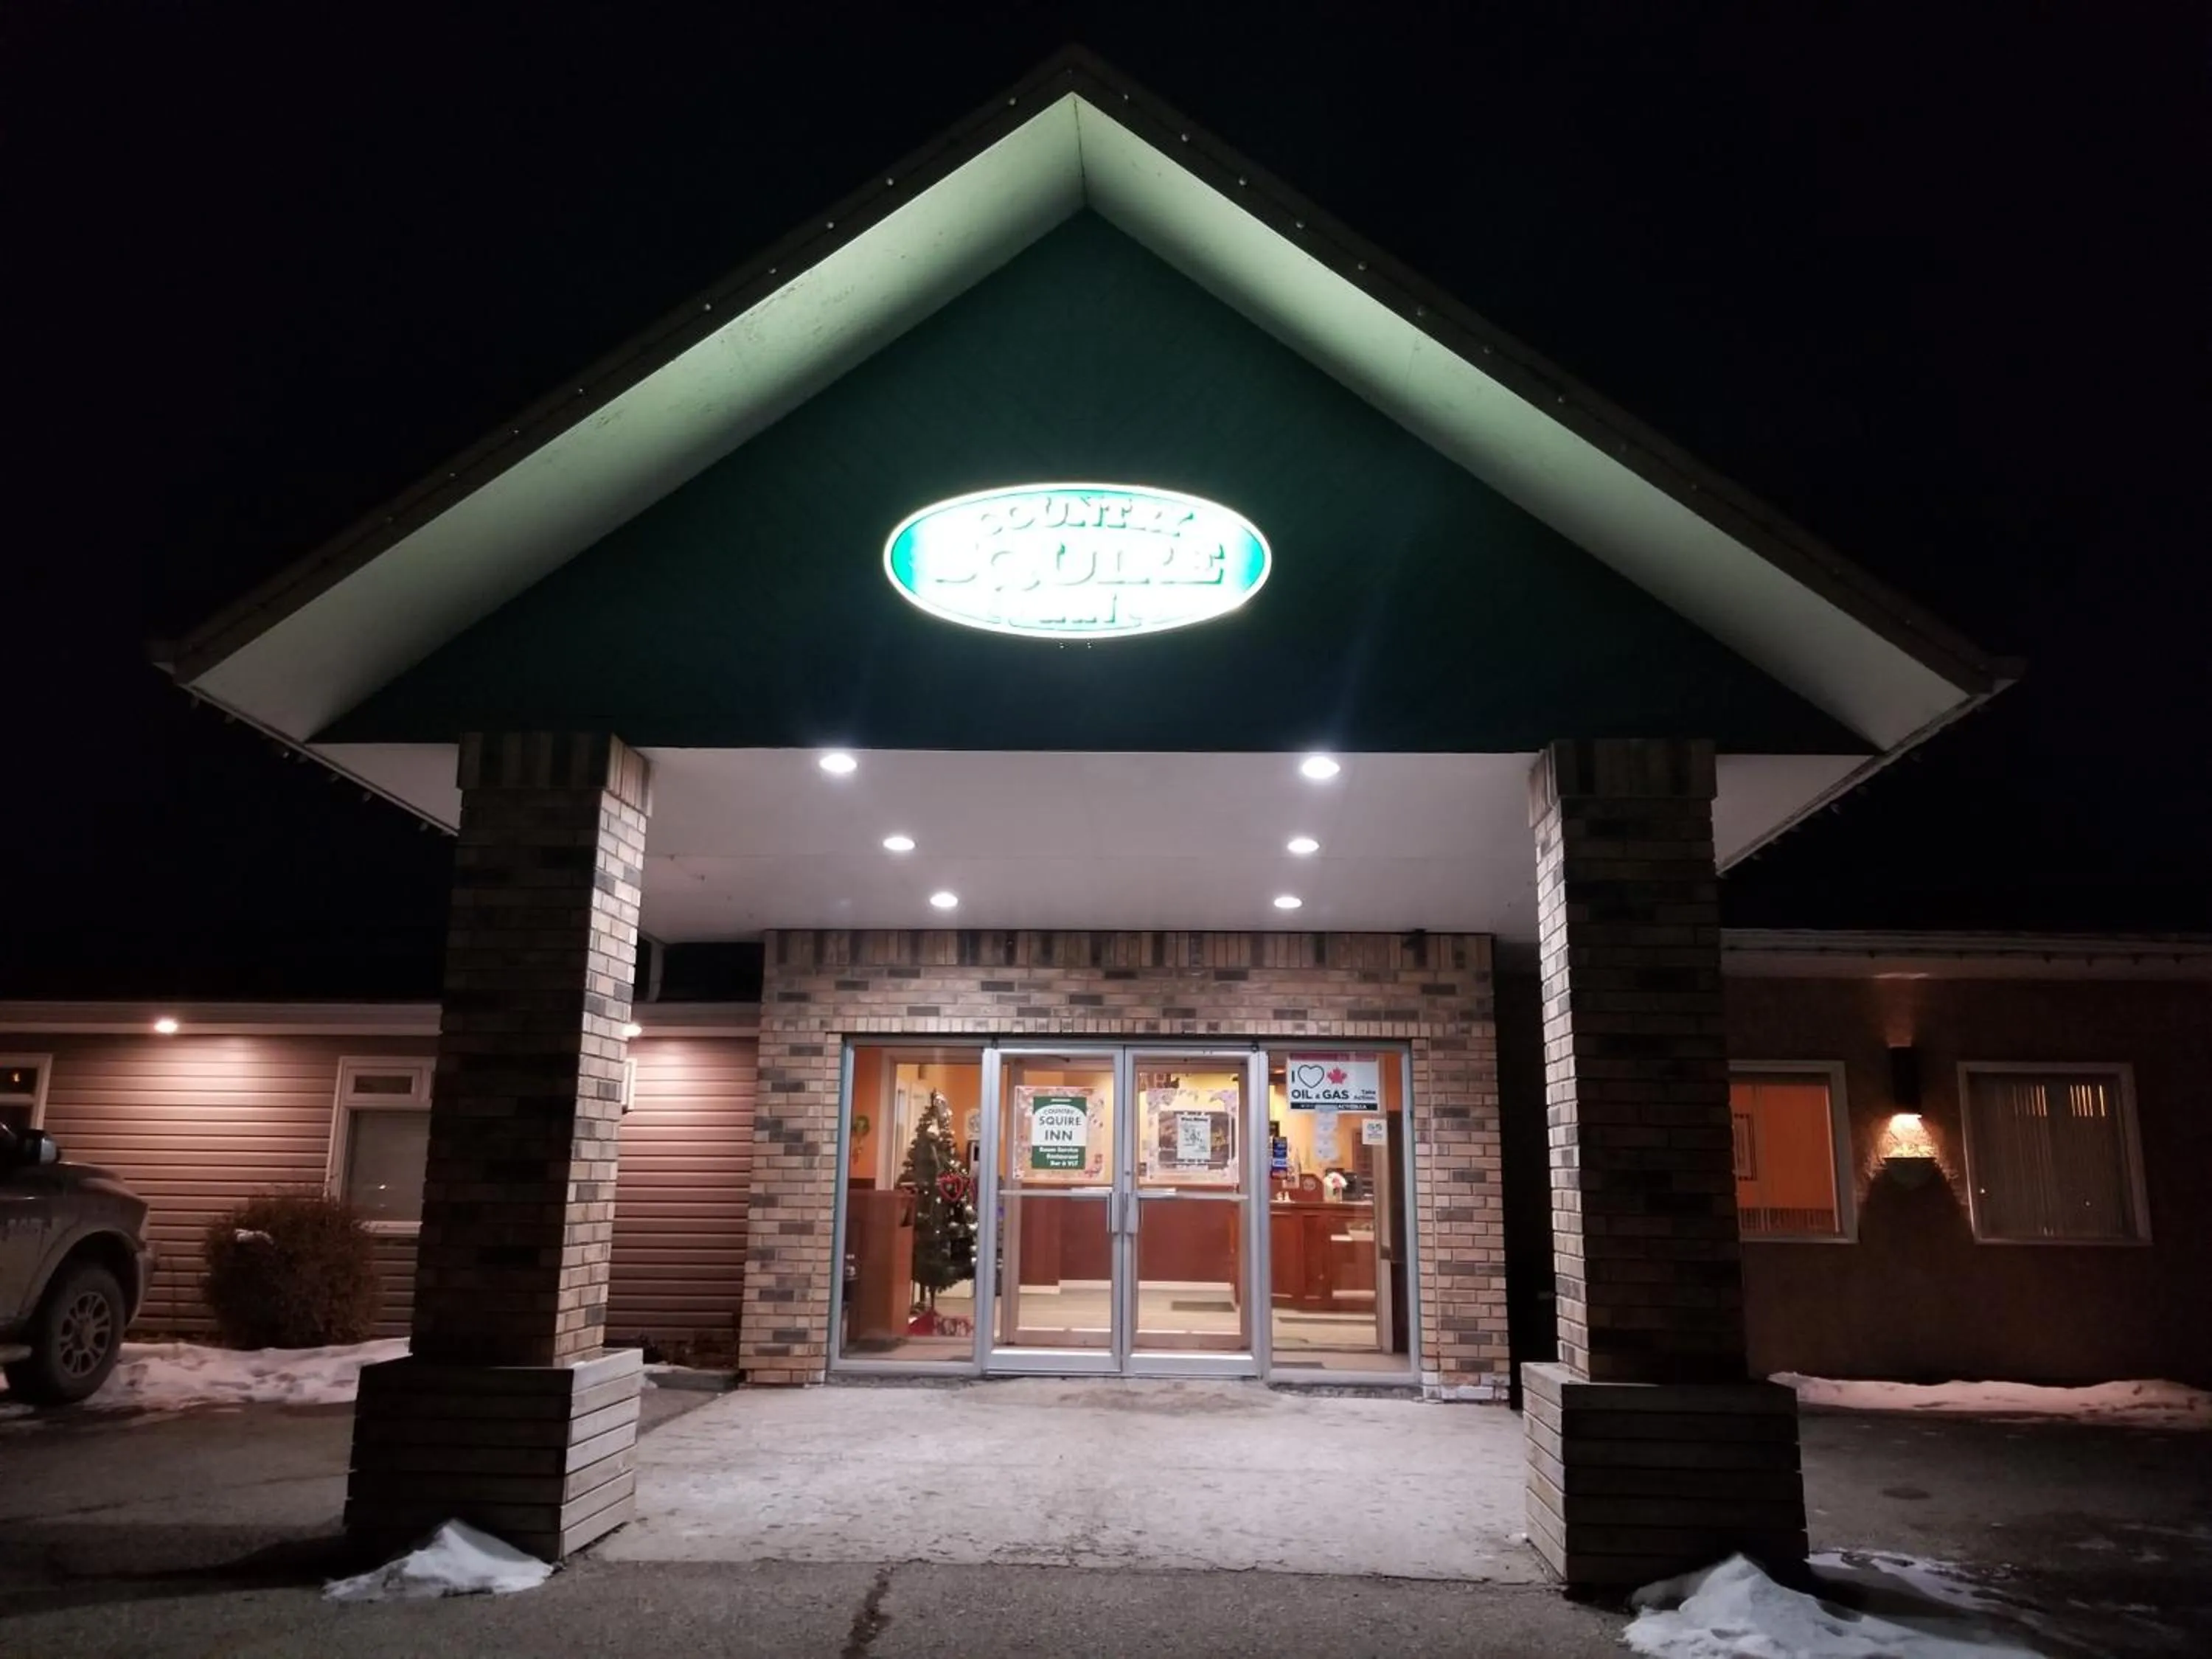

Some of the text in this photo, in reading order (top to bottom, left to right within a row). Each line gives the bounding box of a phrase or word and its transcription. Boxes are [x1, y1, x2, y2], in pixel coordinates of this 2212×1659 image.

[1291, 1070, 1295, 1083] I
[1291, 1089, 1313, 1099] OIL
[1322, 1089, 1349, 1099] GAS
[1039, 1116, 1082, 1126] SQUIRE
[1045, 1130, 1073, 1141] INN
